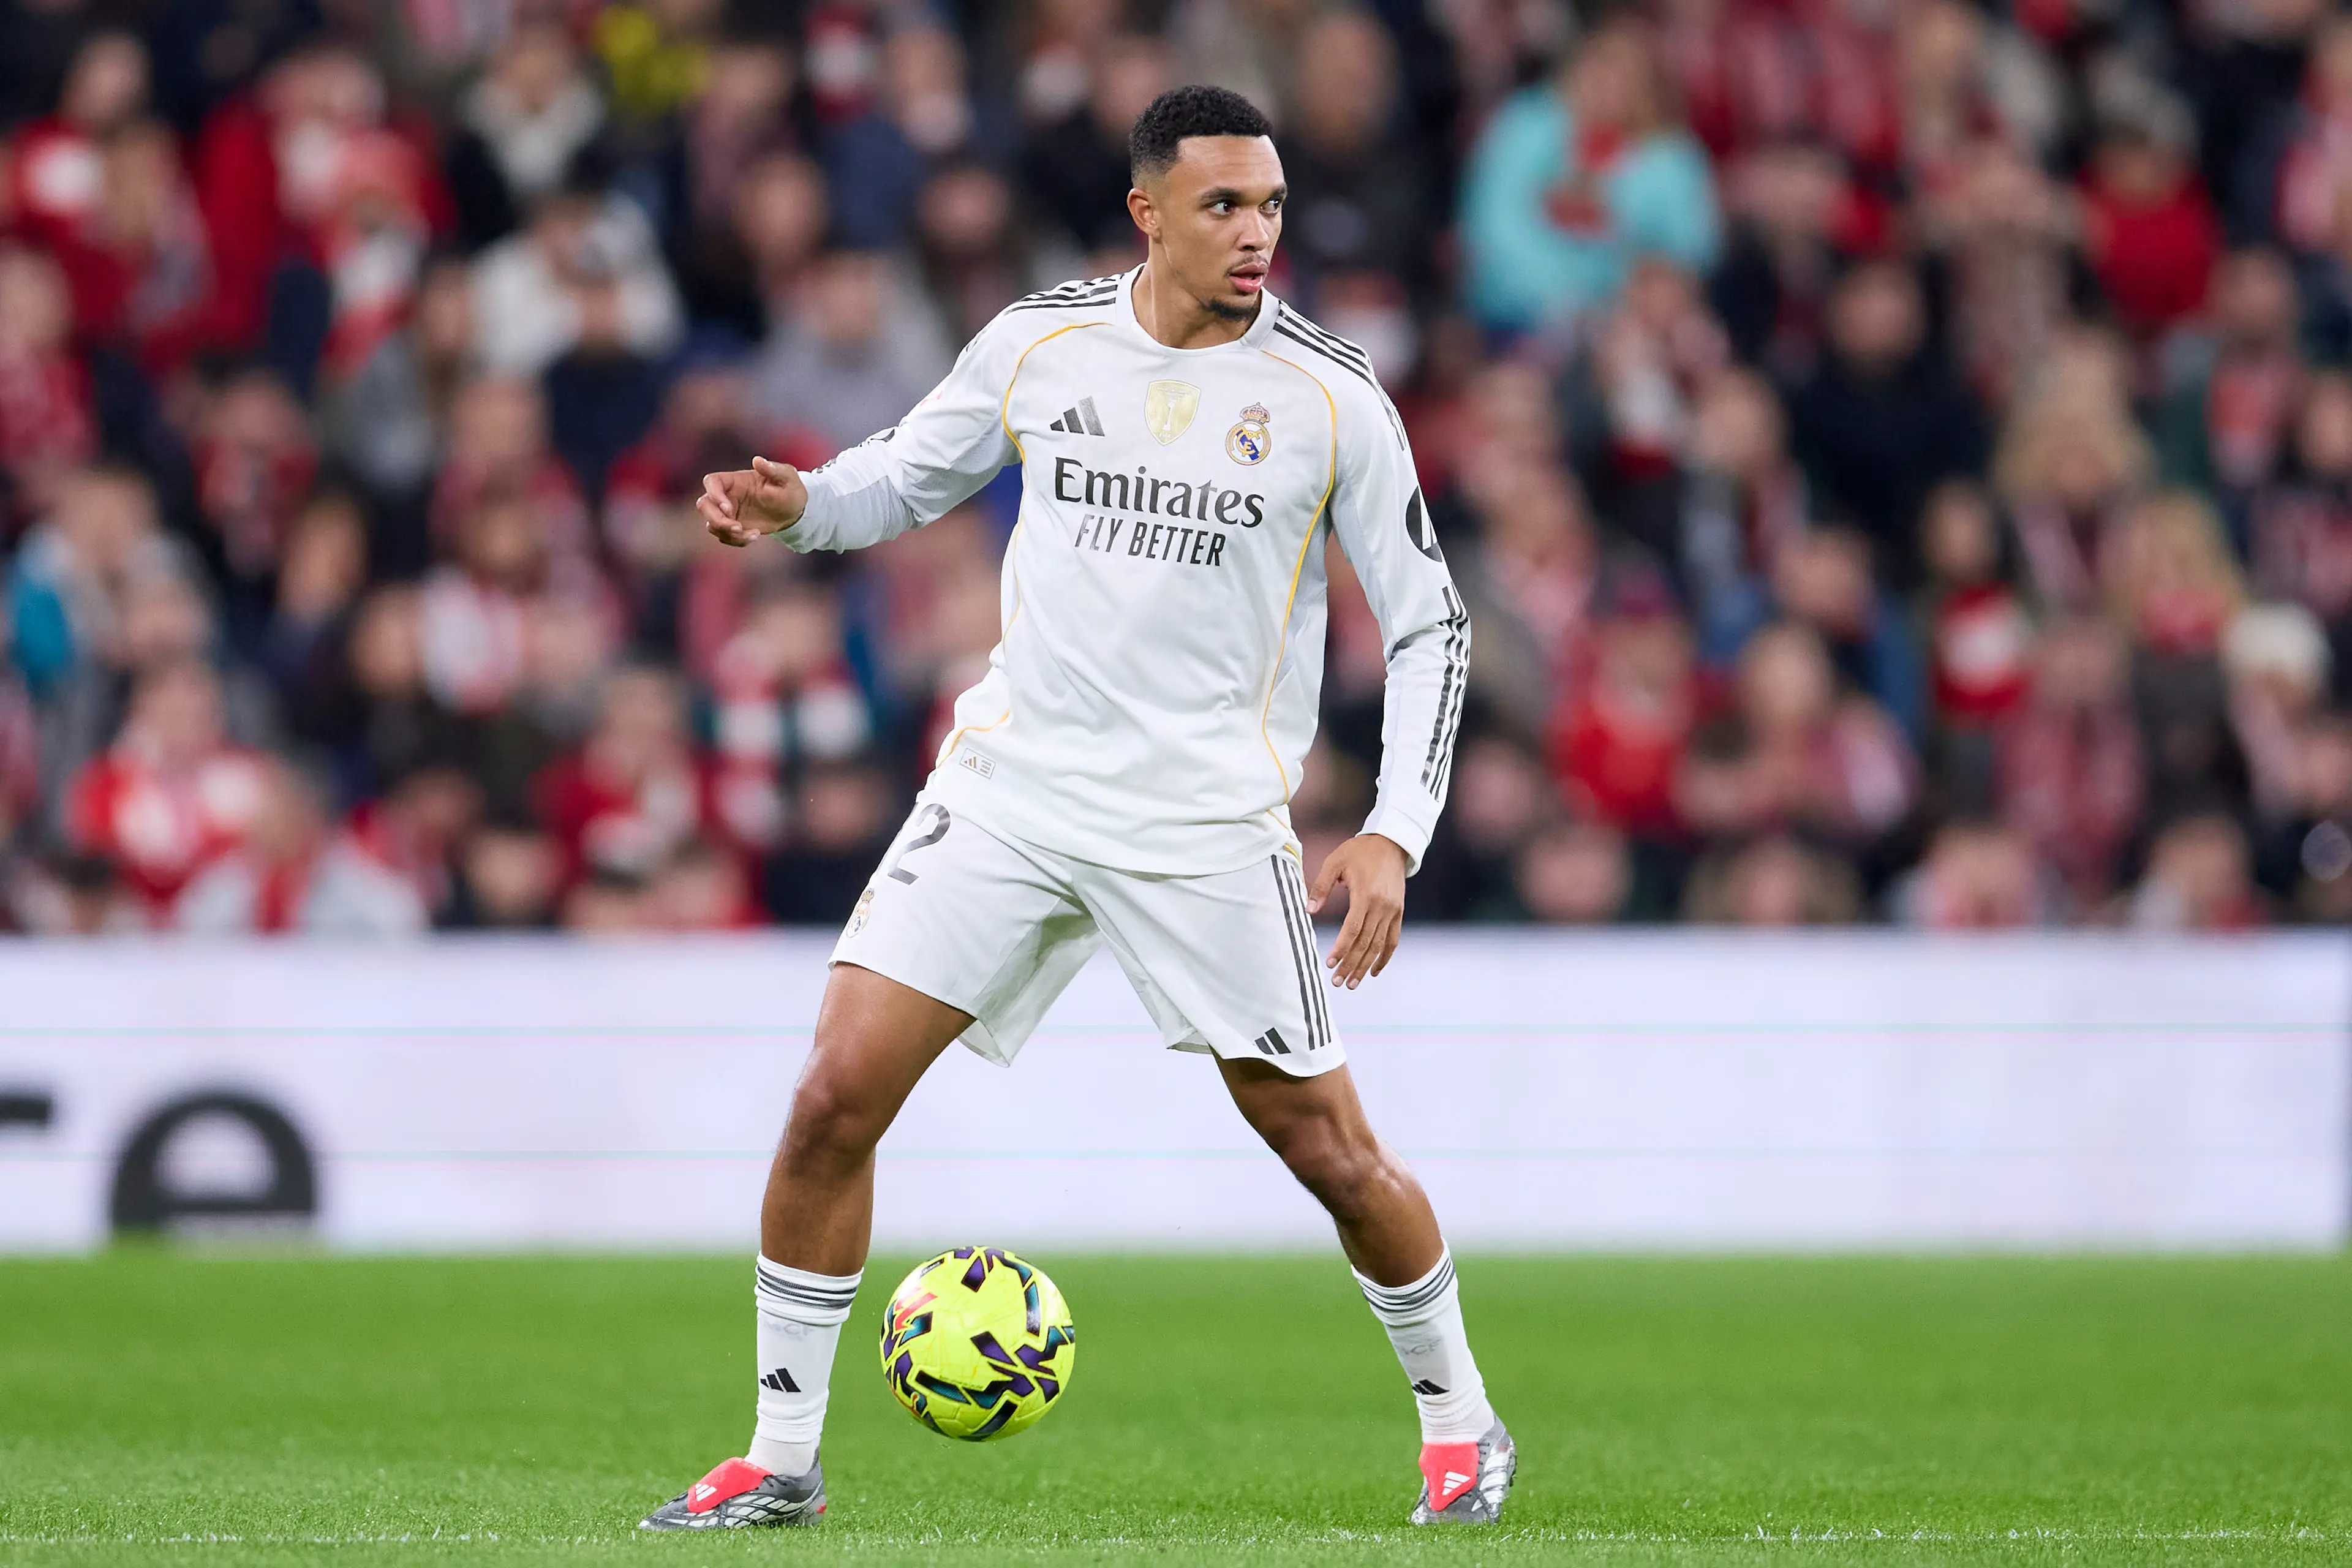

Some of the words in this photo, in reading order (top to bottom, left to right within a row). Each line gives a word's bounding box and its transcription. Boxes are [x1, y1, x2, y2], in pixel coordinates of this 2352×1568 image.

[1055, 456, 1264, 529] Emirates
[1074, 513, 1124, 552] FLY
[1128, 521, 1227, 567] BETTER
[876, 801, 951, 886] 2
[0, 1084, 317, 1237] e
